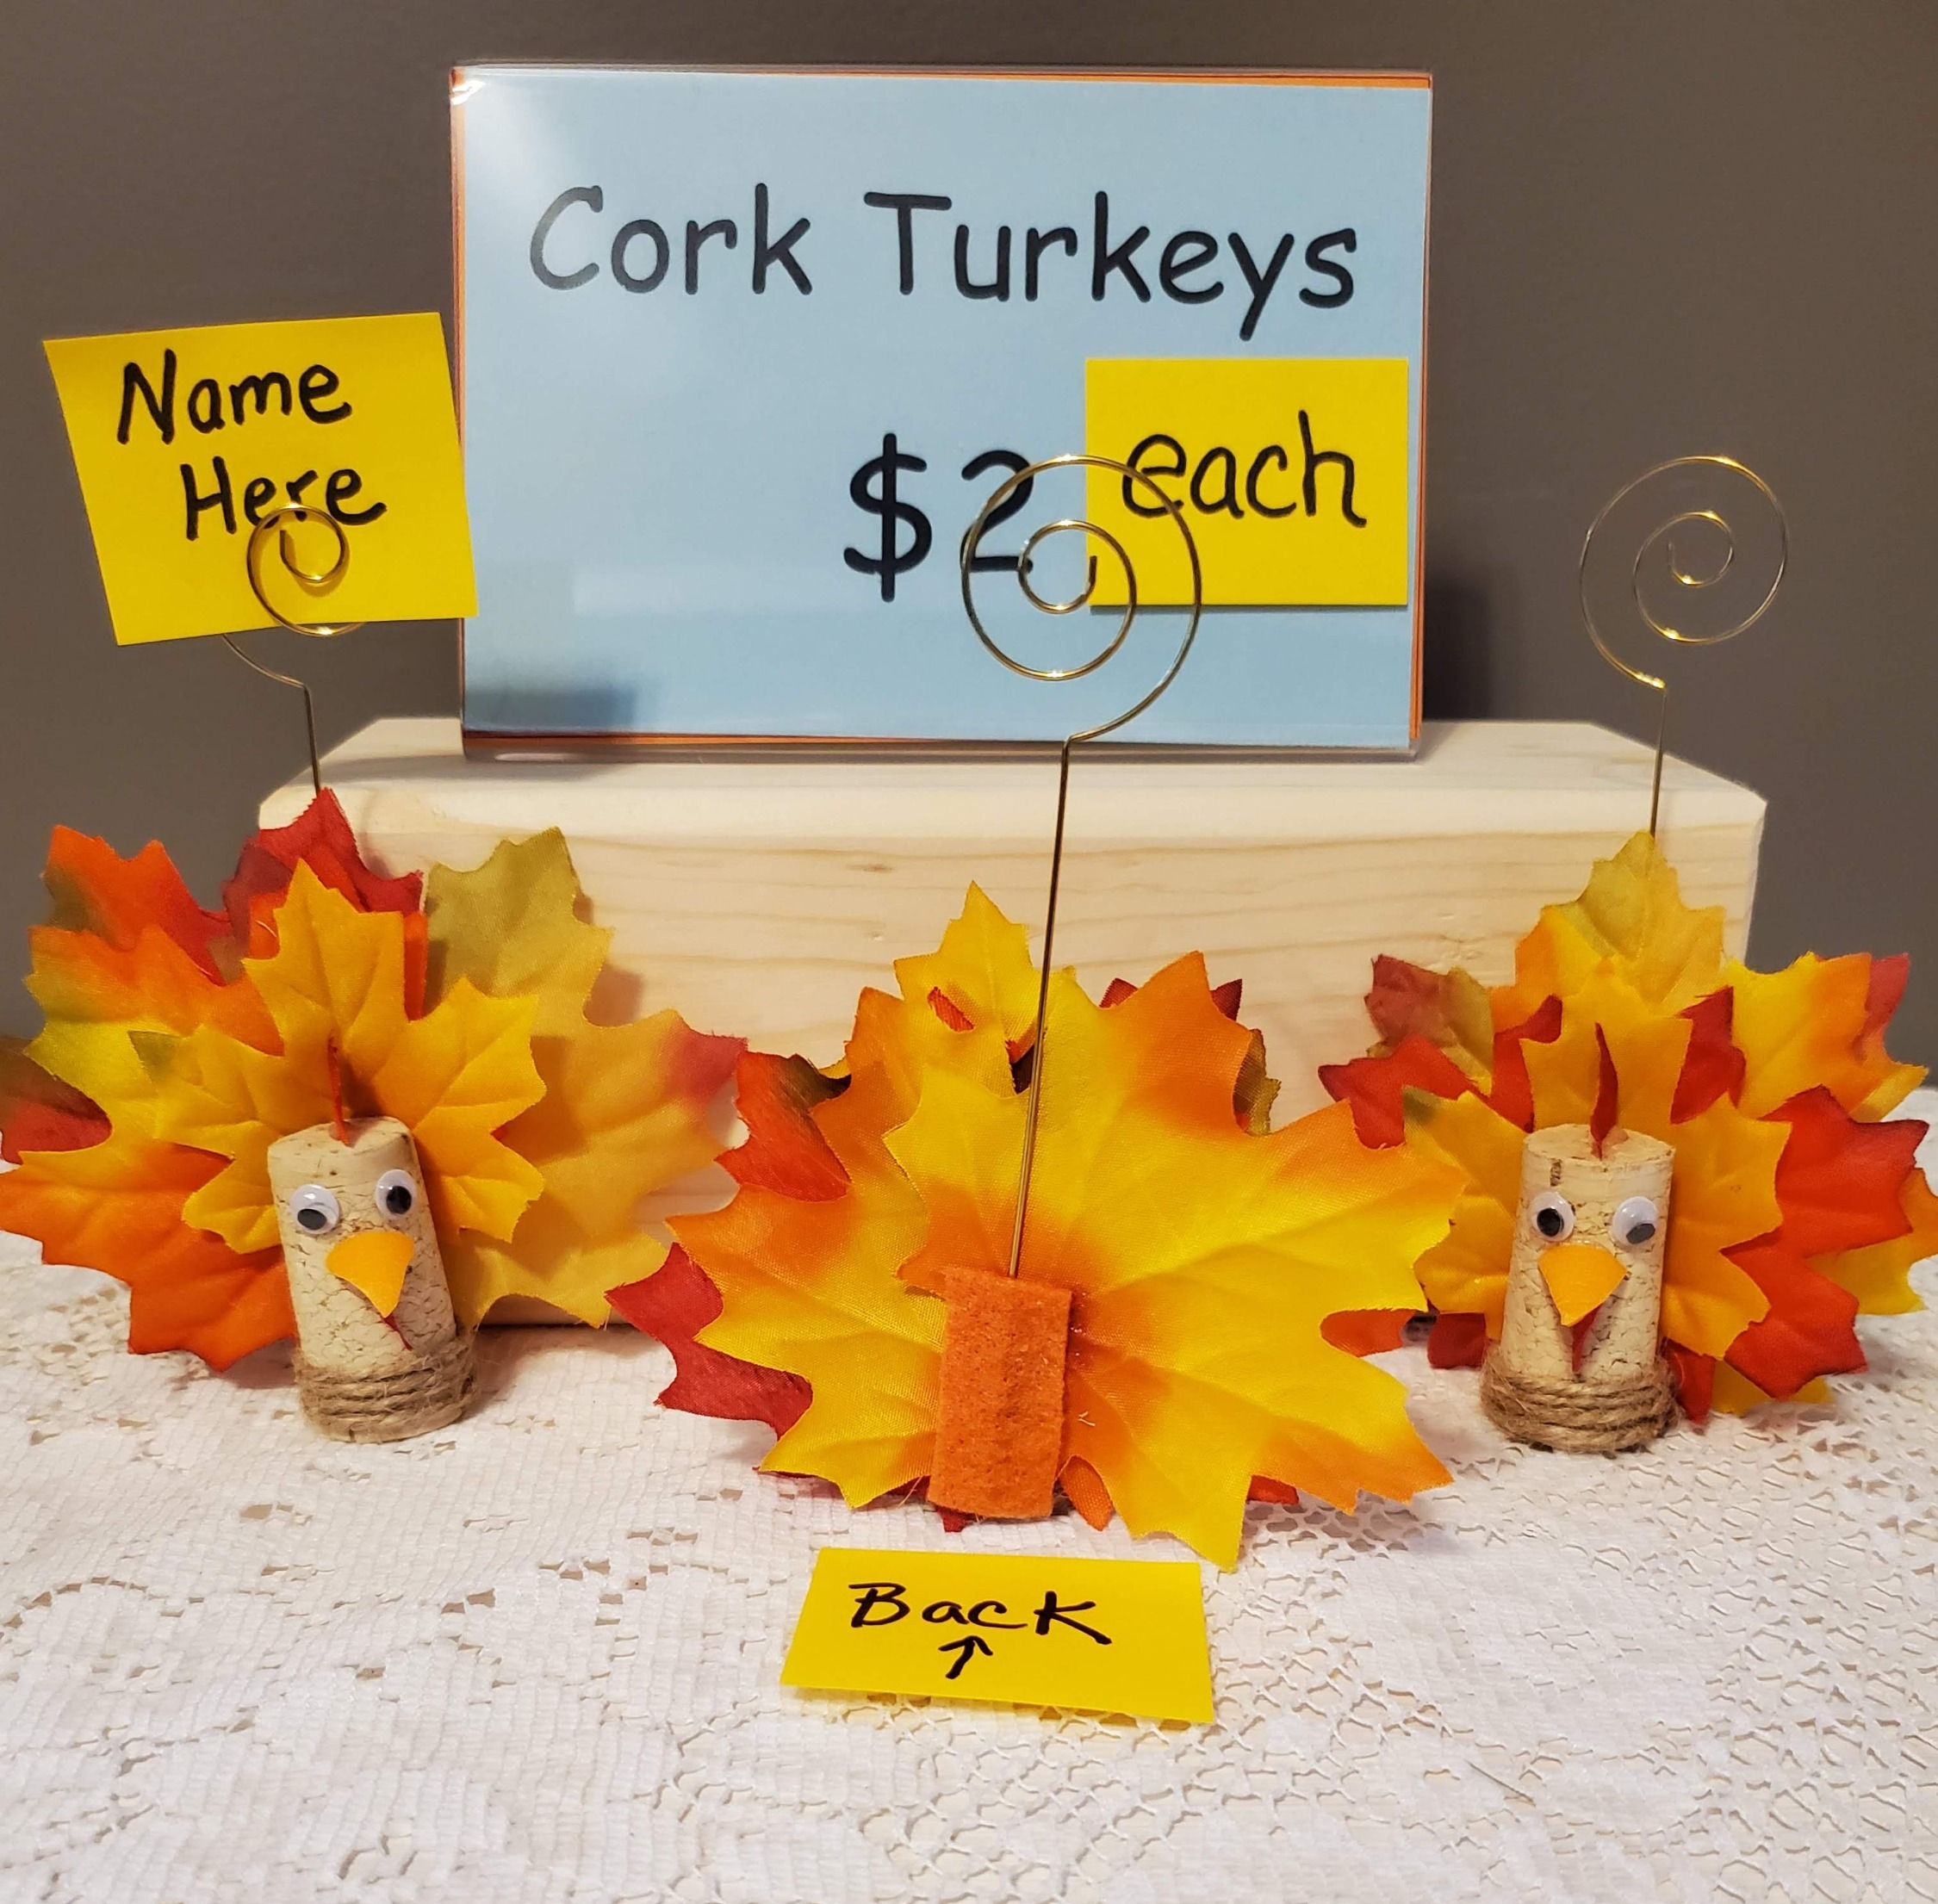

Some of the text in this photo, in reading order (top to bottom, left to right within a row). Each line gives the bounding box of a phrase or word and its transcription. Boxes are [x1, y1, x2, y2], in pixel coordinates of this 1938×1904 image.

[530, 183, 1358, 342] Cork Turkeys
[117, 348, 352, 445] Name
[179, 455, 388, 542] Here
[843, 432, 1034, 603] $2
[1122, 409, 1368, 529] each
